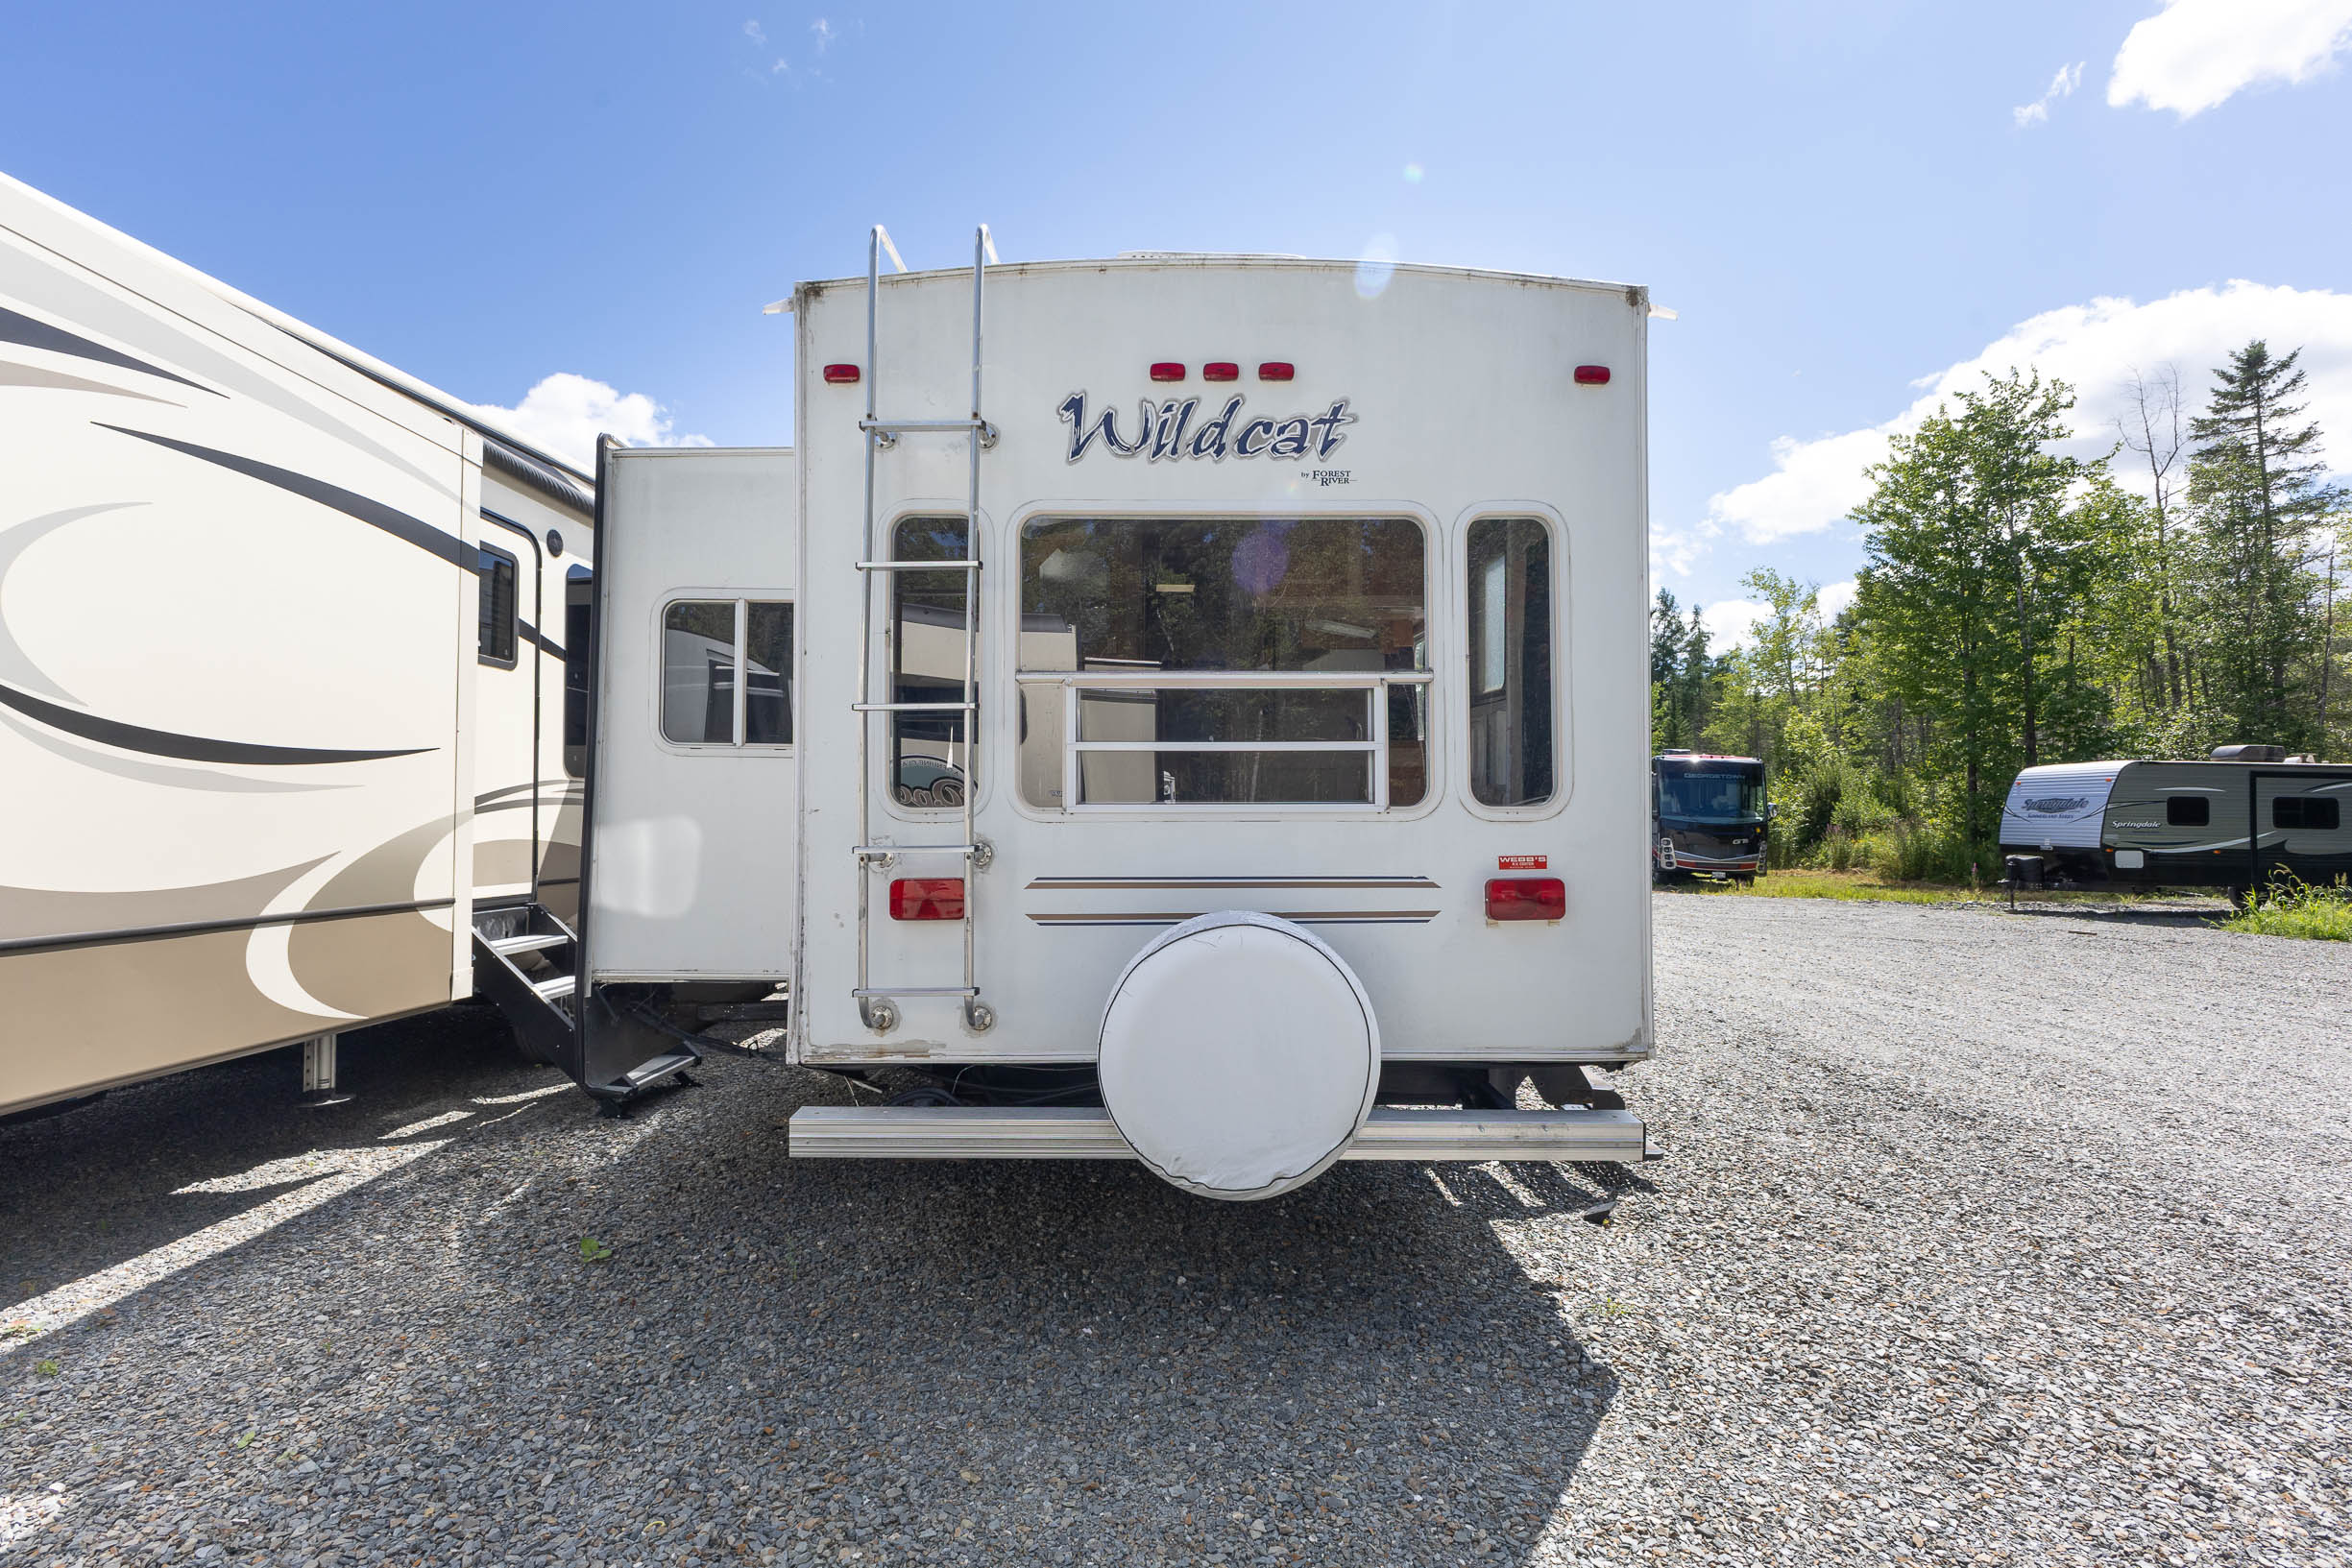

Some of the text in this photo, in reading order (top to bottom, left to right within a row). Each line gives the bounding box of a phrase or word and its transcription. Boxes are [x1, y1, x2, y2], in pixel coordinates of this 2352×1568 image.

[1057, 391, 1358, 463] Wildcat
[1312, 470, 1351, 480] FOREST
[1321, 477, 1350, 487] RIVER
[2112, 820, 2161, 829] Springdale
